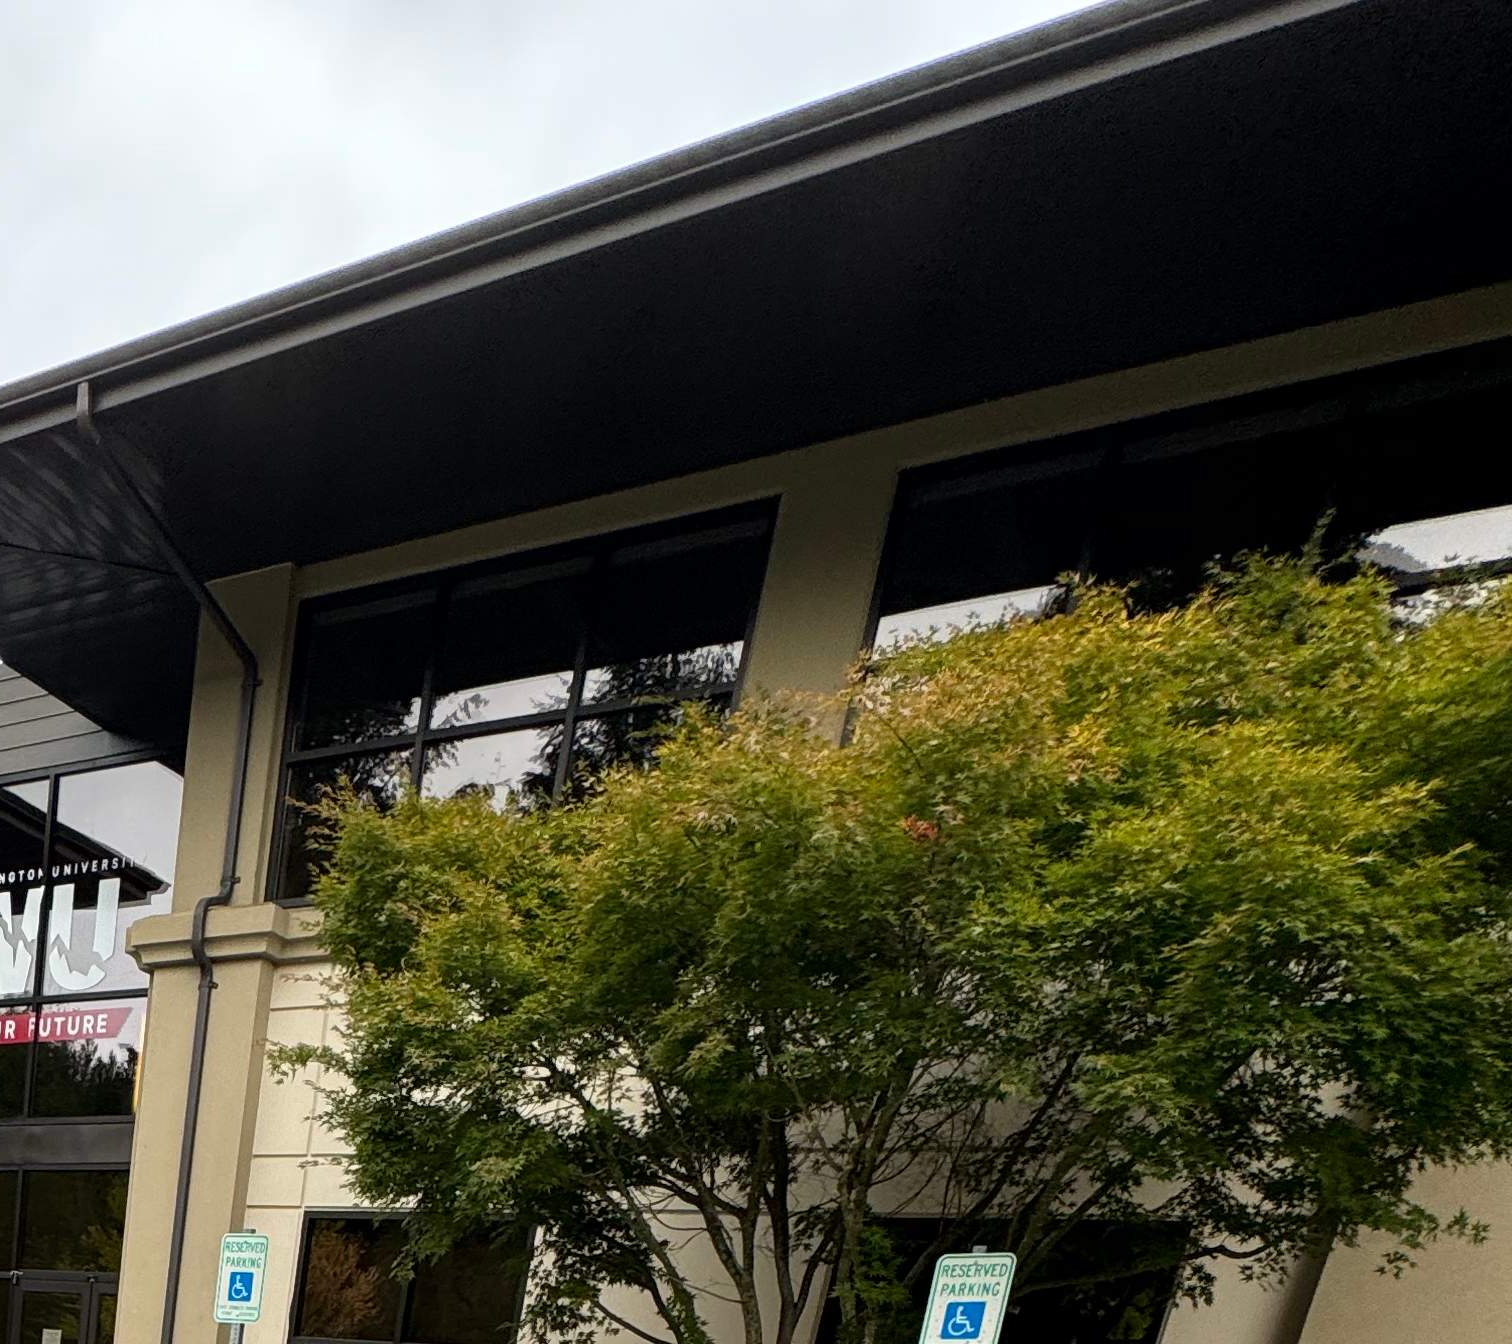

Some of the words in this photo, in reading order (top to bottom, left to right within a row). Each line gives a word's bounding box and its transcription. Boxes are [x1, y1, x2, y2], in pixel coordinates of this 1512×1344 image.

[51, 852, 147, 878] UNIVERSIT
[28, 1013, 108, 1039] FUTURE
[224, 1241, 265, 1254] RESERVED
[225, 1256, 262, 1269] PARKING
[941, 1262, 1008, 1278] RESERVED
[940, 1282, 1001, 1297] PARKING
